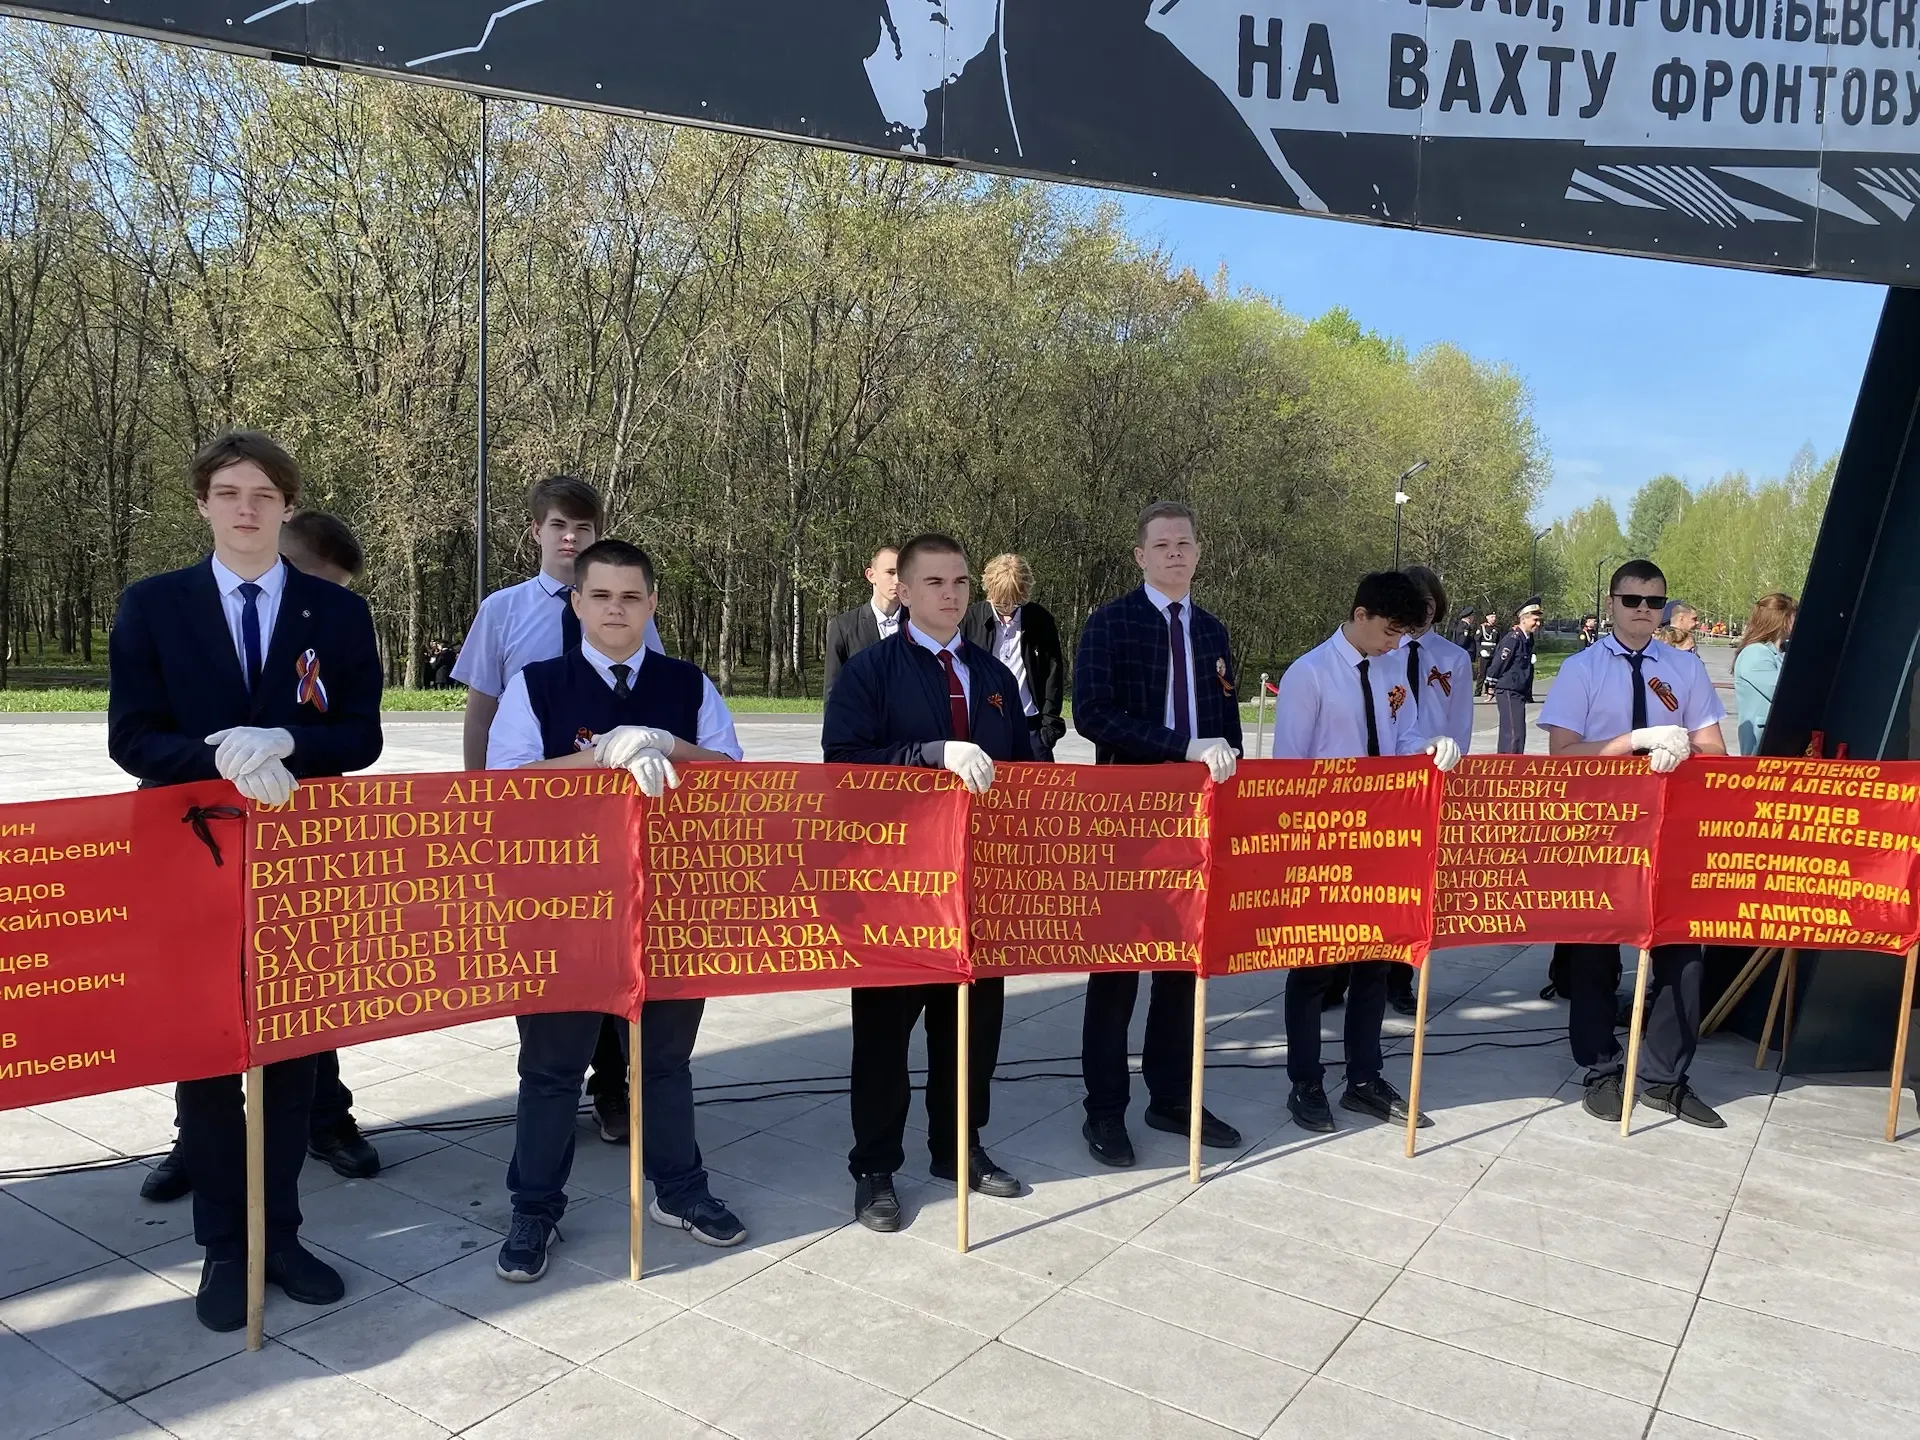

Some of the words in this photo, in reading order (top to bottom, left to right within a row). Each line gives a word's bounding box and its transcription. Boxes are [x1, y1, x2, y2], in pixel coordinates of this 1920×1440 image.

[1237, 14, 1340, 104] НА
[1388, 32, 1617, 119] ВАХТУ
[1522, 756, 1652, 777] АНАТОЛИЙ
[1237, 777, 1327, 799] АЛЕКСАНДР
[1331, 768, 1429, 794] ЯКОВЛЕВИЧ
[1442, 778, 1568, 799] АСИЛЬЕВИЧ
[1704, 772, 1785, 792] ТРОФИМ
[1790, 778, 1920, 803] АЛЕКСЕЕВИ
[646, 792, 825, 819] ДАВЫДОВИЧ
[1040, 791, 1205, 813] НИКОЛАЕВИЧ
[1754, 801, 1860, 826] ЖЕЛУДЕВ
[254, 810, 495, 851] ГАВРИЛОВИЧ
[648, 818, 765, 845] БАРМИН
[791, 818, 908, 846] ТРИФОН
[971, 813, 1081, 837] БУТАКОВ
[1086, 813, 1210, 838] АФАНАСИЙ
[1278, 810, 1367, 833] ФЕДОРОВ
[1470, 824, 1617, 843] КИРИЛЛОВИЧ
[1231, 832, 1311, 856] ВАЛЕНТИН
[1316, 829, 1422, 851] АРТЕМОВИЧ
[1698, 819, 1784, 840] НИКОЛАЙ
[1788, 824, 1920, 855] АЛЕКСЕЕВИЧ
[251, 850, 406, 890] ВЯТКИН
[426, 832, 601, 869] ВАСИЛИЙ
[650, 843, 806, 870] ИВАНОВИЧ
[973, 839, 1115, 866] КИРИЛЛОВИЧ
[1533, 845, 1652, 868] ЛЮДМИЛА
[1706, 852, 1850, 877] КОЛЕСНИКОВА
[650, 869, 767, 896] ТУРЛЮК
[789, 869, 958, 897] АЛЕКСАНДР
[972, 866, 1066, 892] БУТАКОВА
[1072, 869, 1207, 892] ВАЛЕНТИНА
[1285, 865, 1353, 884] ИВАНОВ
[255, 873, 496, 923] ГАВРИЛОВИЧ
[1229, 886, 1311, 911] АЛЕКСАНДР
[1319, 886, 1422, 906] ТИХОНОВИЧ
[1433, 891, 1478, 912] АРТЭ
[1483, 890, 1613, 910] ЕКАТЕРИНА
[1691, 872, 1756, 890] ЕВГЕНИЯ
[1764, 875, 1911, 905] АЛЕКСАНДРОВНА
[645, 896, 820, 925] АНДРЕЕВИЧ
[974, 892, 1102, 917] АСИЛЬЕВНА
[1738, 902, 1852, 926] АГАПИТОВА
[253, 907, 405, 955] СУГРИН
[434, 890, 615, 927] ТИМОФЕЙ
[1434, 914, 1527, 935] ЕТРОВНА
[1688, 921, 1754, 939] ЯНИНА
[1760, 922, 1902, 949] МАРТЫНОВНА
[645, 924, 843, 953] ДВОЕГЛАЗОВА
[862, 924, 963, 951] МАРИЯ
[255, 925, 508, 981] ВАСИЛЬЕВИЧ
[650, 950, 862, 977] НИКОЛАЕВНА
[1228, 946, 1314, 973] АЛЕКСАНДРА
[1318, 943, 1412, 964] ГЕОРГИЕВНА
[0, 972, 126, 1001] менович
[255, 958, 437, 1012] ШЕРИКОВ
[457, 949, 559, 981] ИВАН
[255, 979, 547, 1045] НИКИФОРОВИЧ
